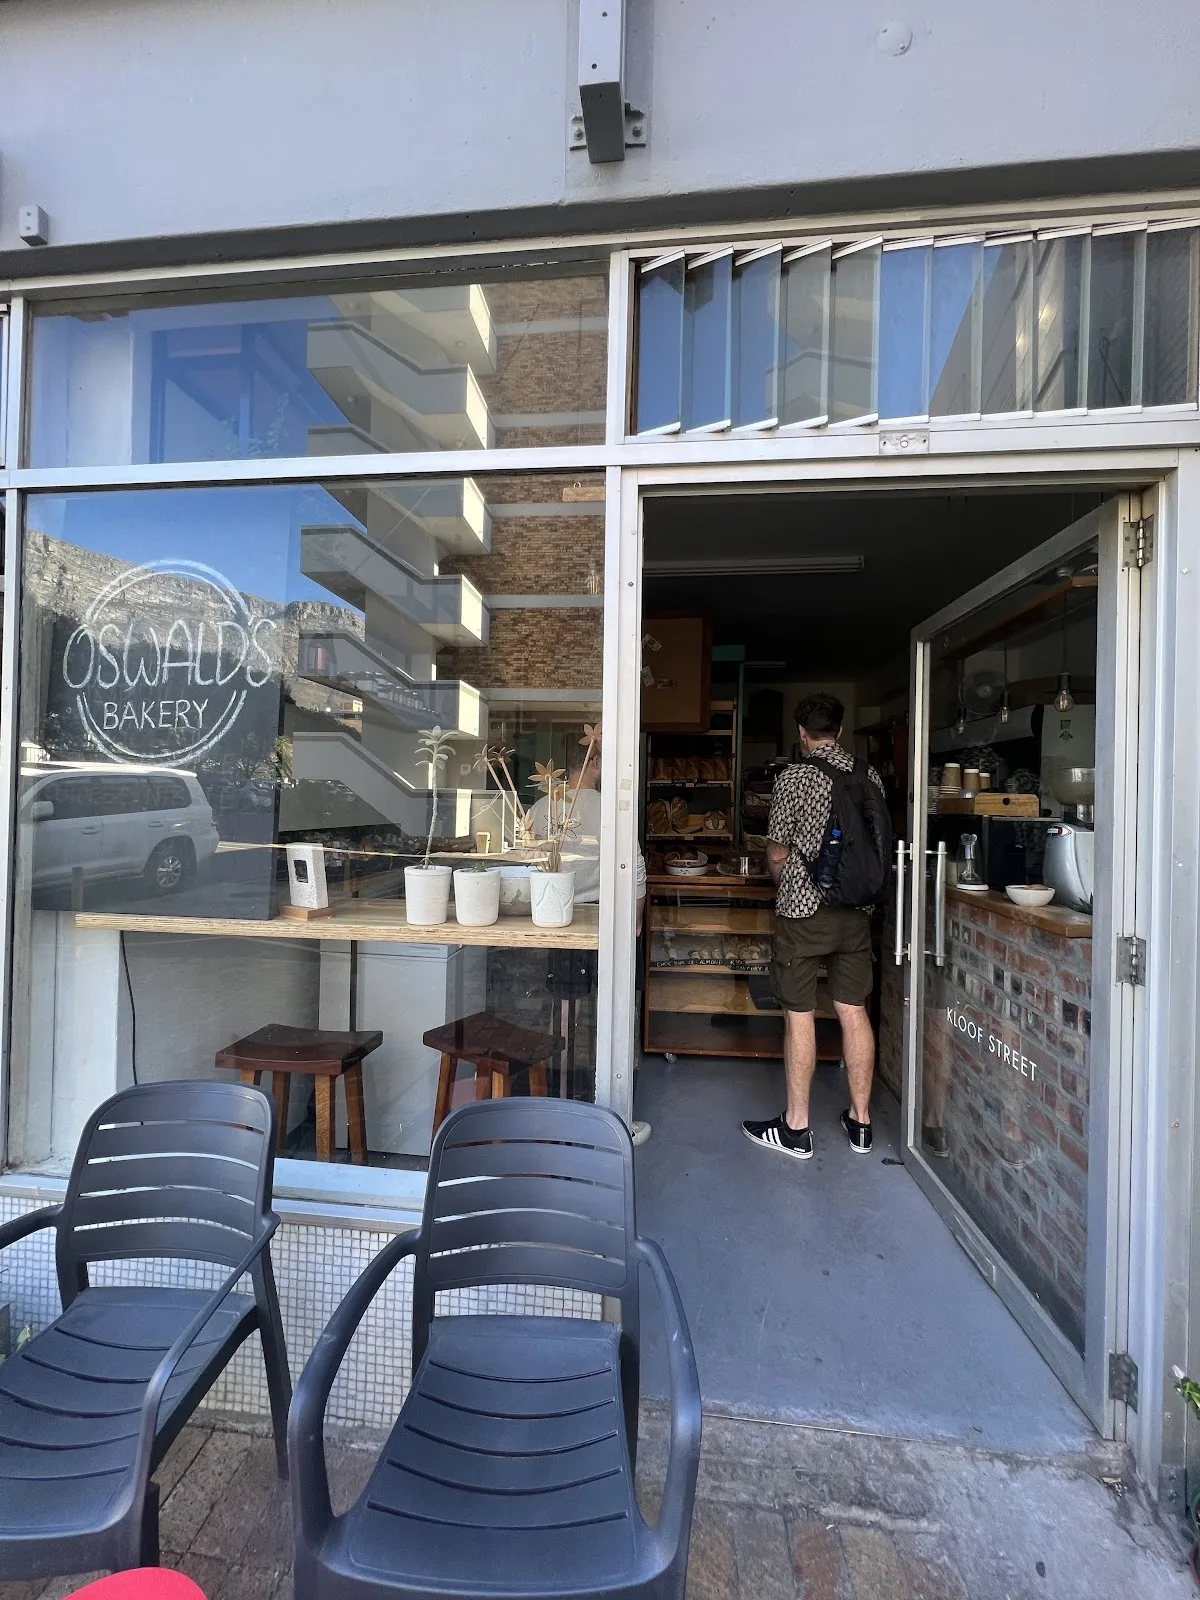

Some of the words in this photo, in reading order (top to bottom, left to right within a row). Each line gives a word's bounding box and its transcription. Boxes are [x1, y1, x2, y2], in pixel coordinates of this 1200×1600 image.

[62, 614, 277, 690] OSWALD'S
[102, 699, 209, 731] BAKERY
[946, 1006, 983, 1043] KLOOF
[988, 1034, 1038, 1082] STREET
